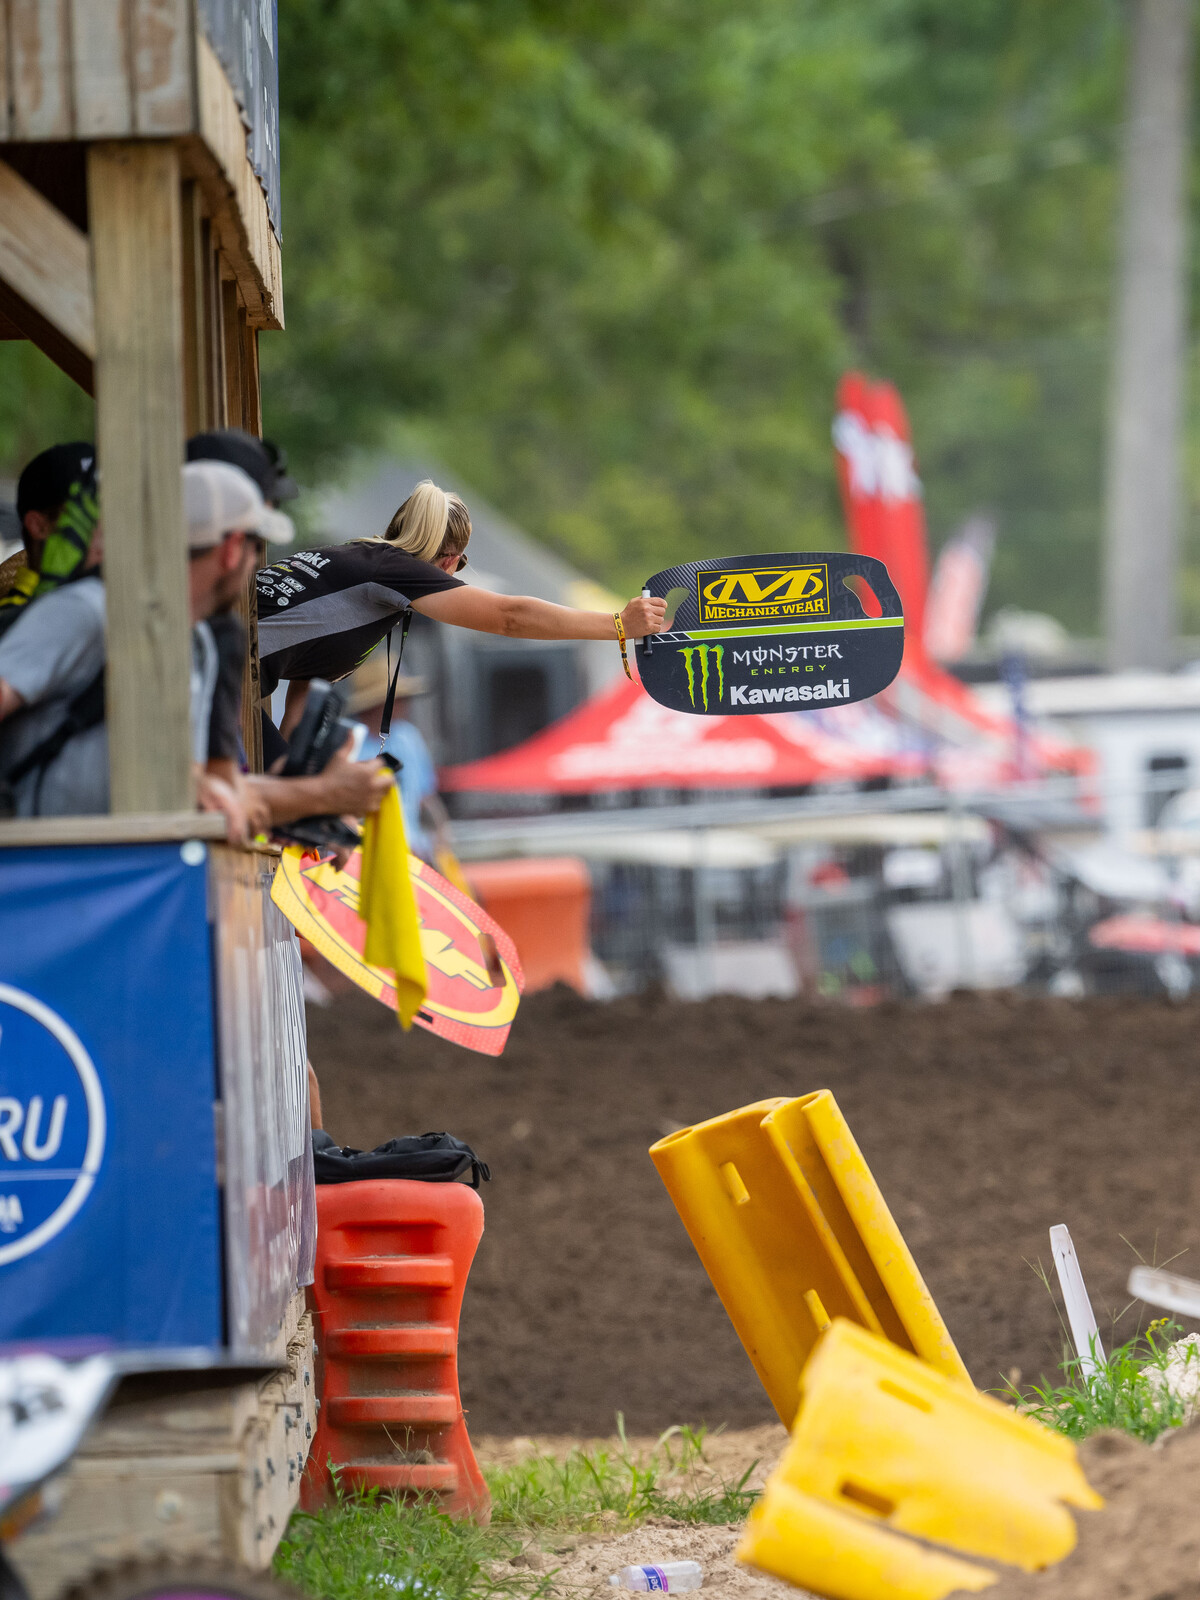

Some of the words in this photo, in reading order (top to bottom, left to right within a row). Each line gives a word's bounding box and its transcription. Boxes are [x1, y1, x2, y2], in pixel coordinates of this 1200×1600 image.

[704, 604, 780, 620] MECHANIX
[782, 598, 825, 614] WEAR
[732, 644, 843, 666] MONSTER
[751, 664, 827, 676] ENERGY
[730, 678, 850, 706] Kawasaki
